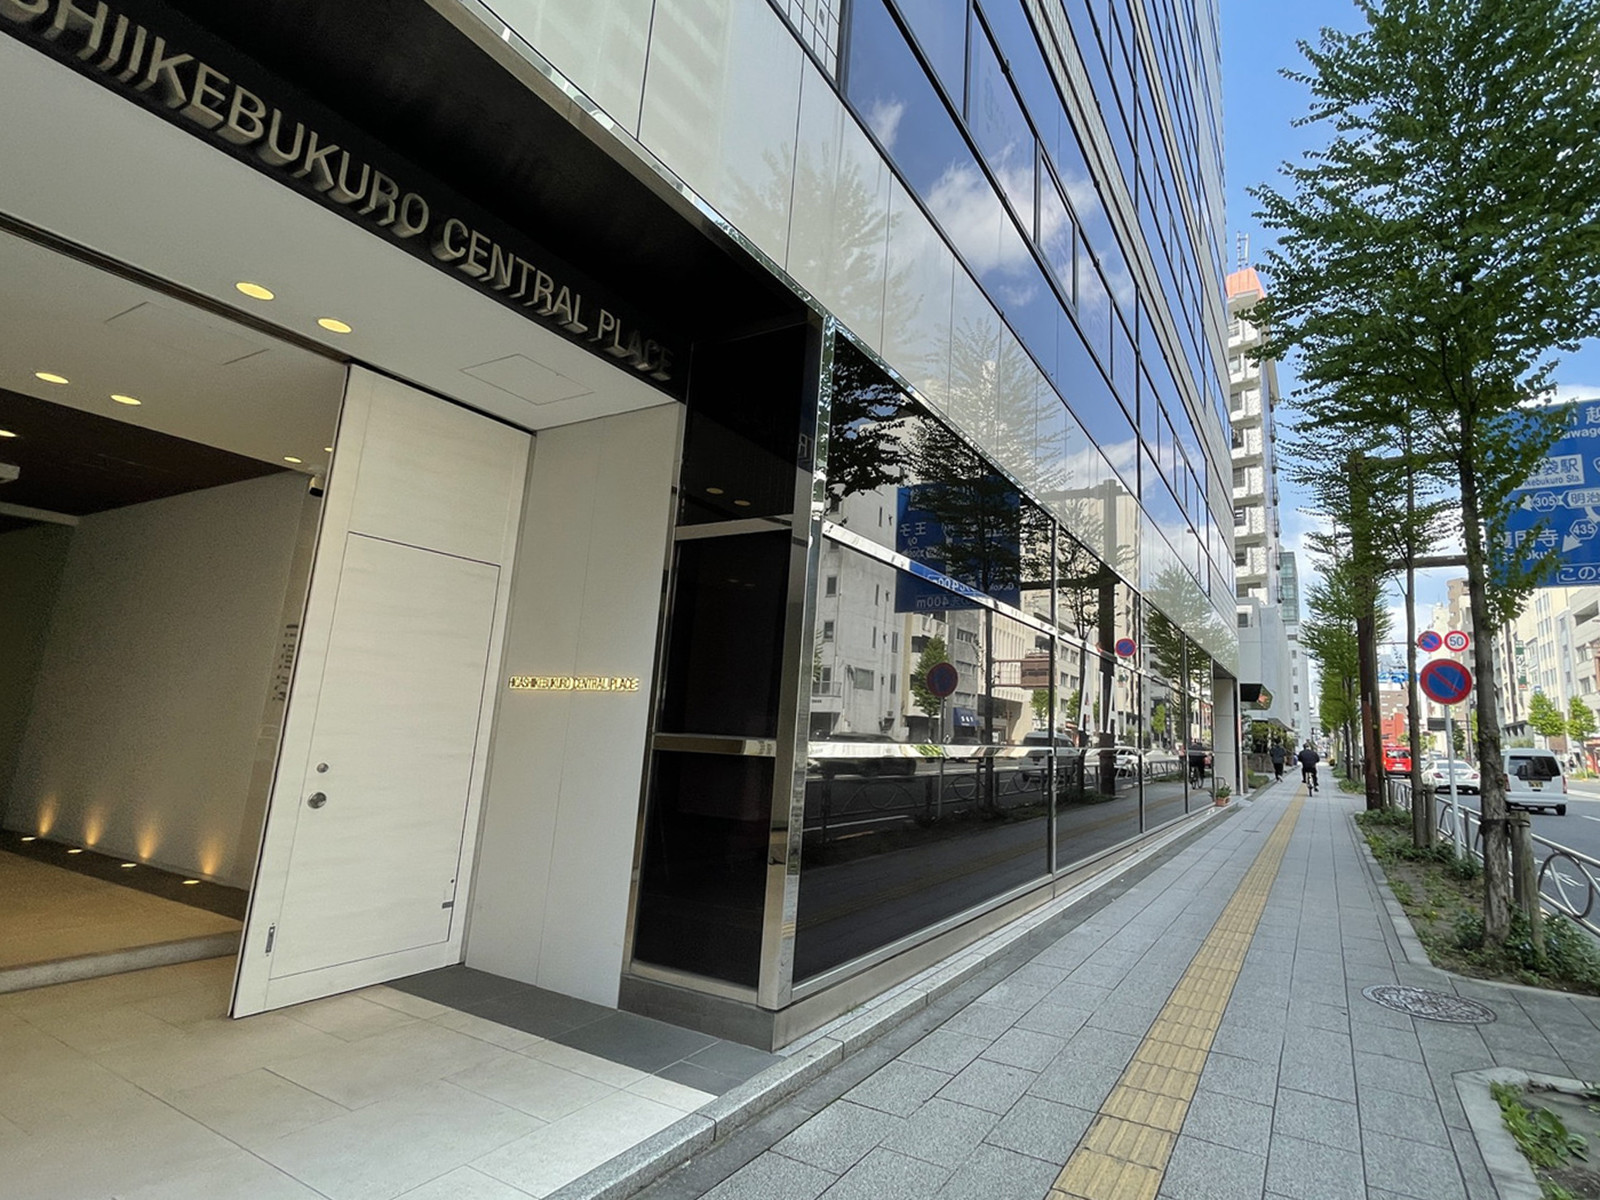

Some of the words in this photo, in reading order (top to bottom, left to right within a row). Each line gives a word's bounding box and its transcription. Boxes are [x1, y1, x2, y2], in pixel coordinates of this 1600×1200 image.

[435, 218, 588, 334] CENTRAL
[594, 308, 675, 380] PLACE
[1531, 457, 1580, 477] 袋駅
[1535, 496, 1556, 507] 305
[1572, 523, 1595, 535] 435
[1449, 635, 1465, 647] 50
